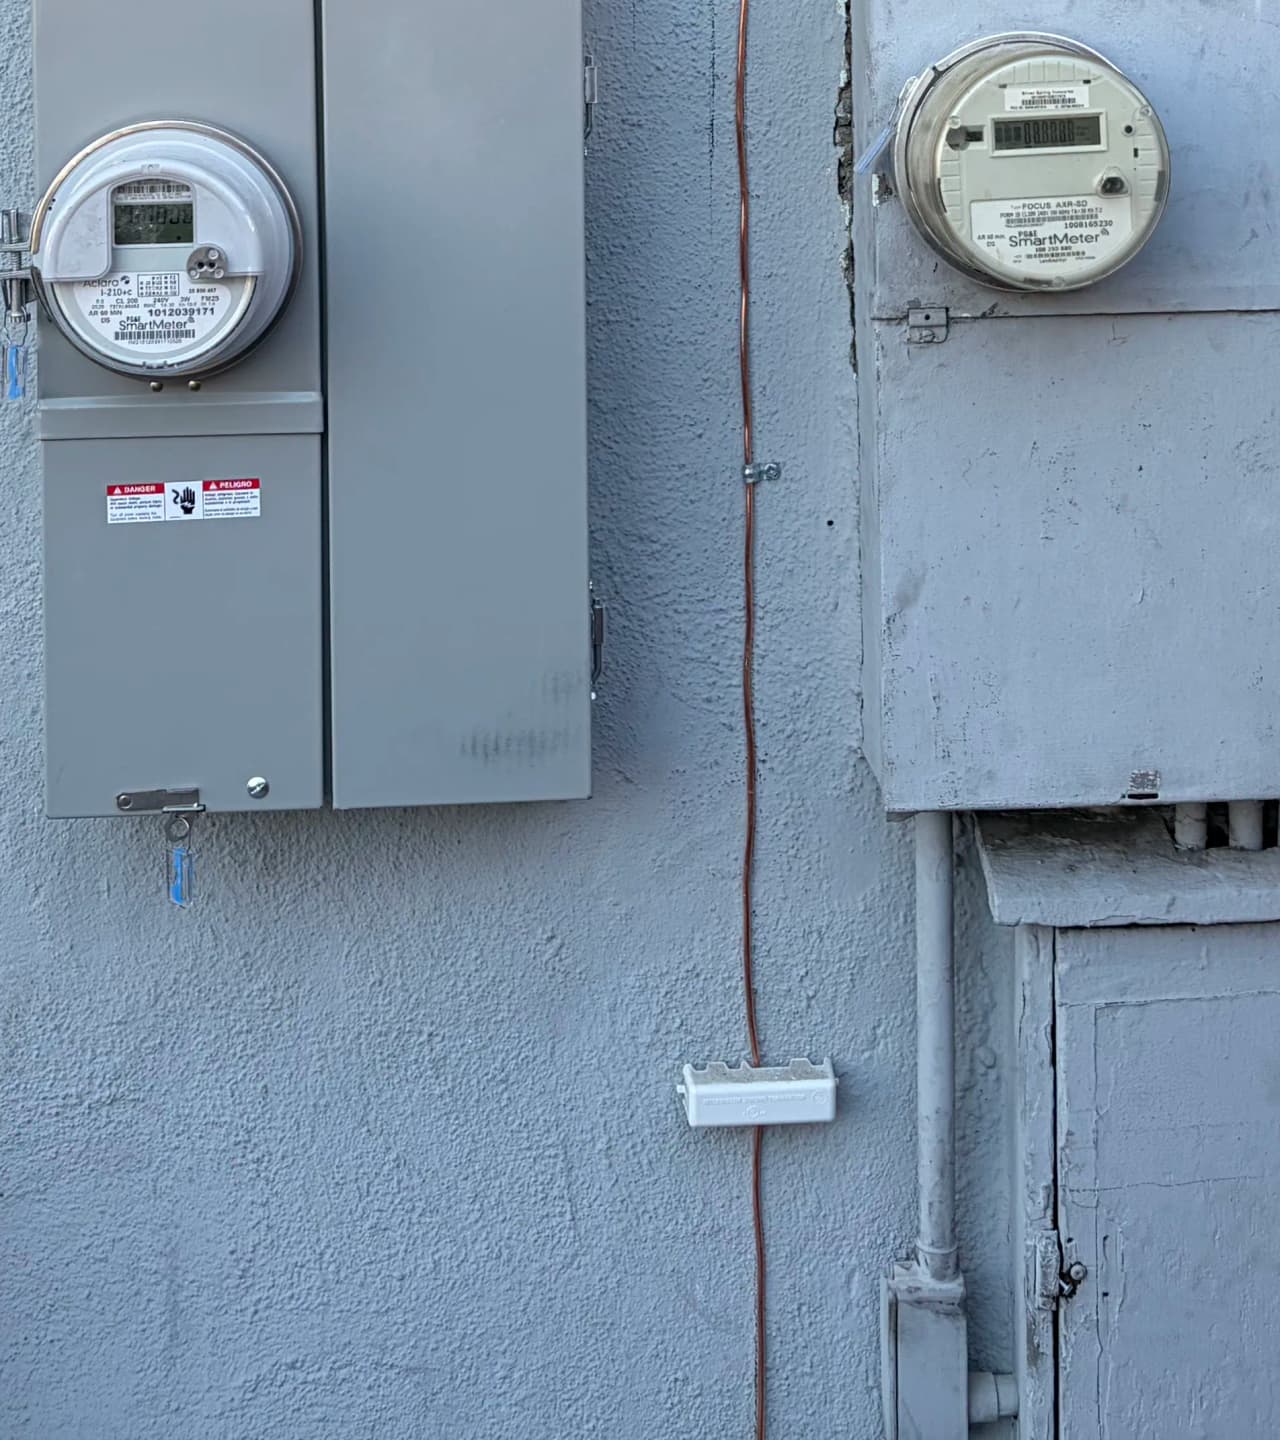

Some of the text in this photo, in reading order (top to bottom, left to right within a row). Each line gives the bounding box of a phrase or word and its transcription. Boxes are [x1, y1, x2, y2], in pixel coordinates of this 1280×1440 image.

[1022, 202, 1051, 210] FOCUS
[1009, 233, 1100, 247] SmartMeter
[83, 279, 120, 288] Aclaro
[148, 307, 215, 317] 1012039171
[119, 319, 187, 331] SmartMeter
[123, 485, 157, 494] DANGER
[219, 481, 253, 489] PELIGRO
